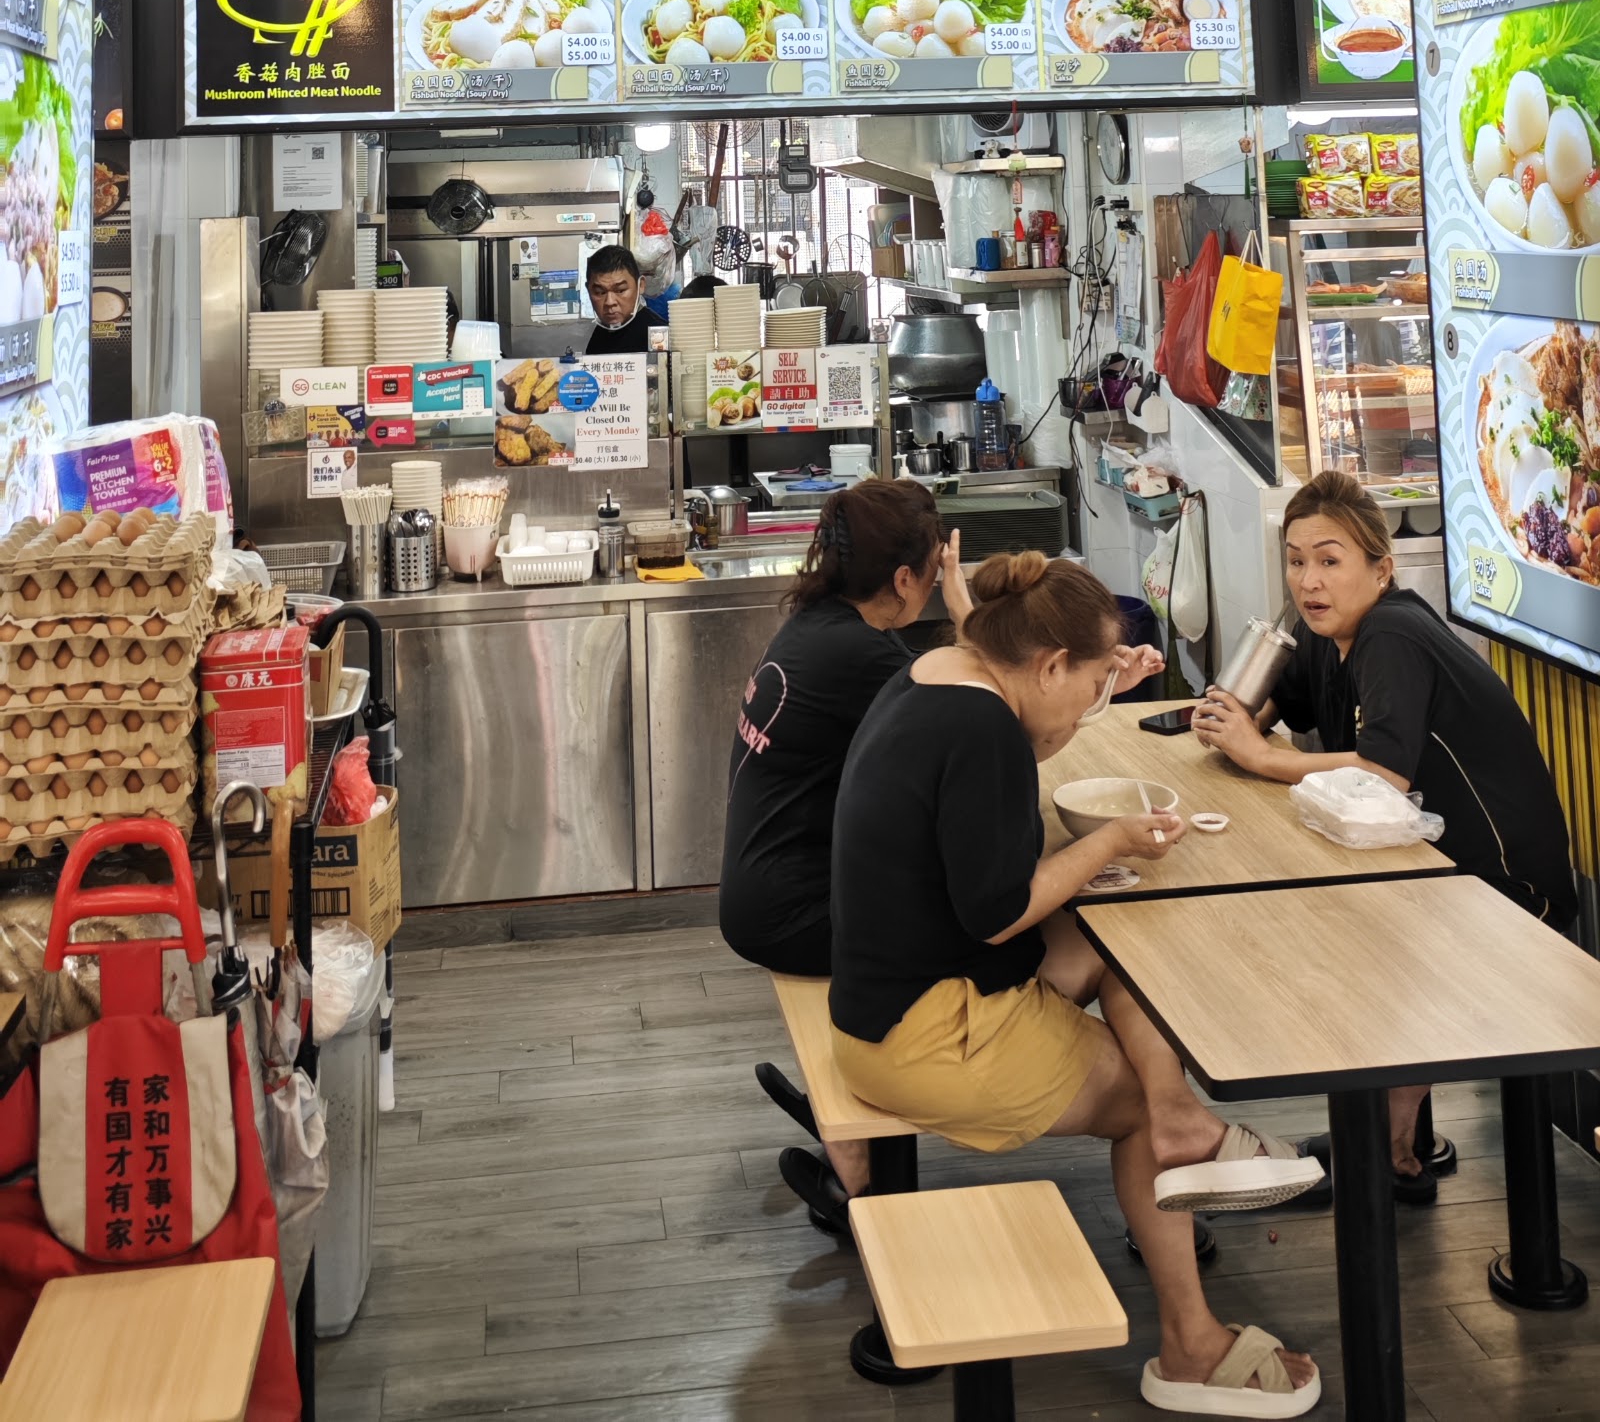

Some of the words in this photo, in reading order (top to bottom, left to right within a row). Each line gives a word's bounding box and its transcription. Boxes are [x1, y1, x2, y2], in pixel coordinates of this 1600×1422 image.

[990, 27, 1019, 36] $4.00
[1021, 29, 1031, 37] (S)
[1195, 23, 1223, 32] $5.30
[1226, 24, 1235, 32] (S)
[567, 37, 597, 47] $4.00
[600, 39, 610, 47] (S)
[781, 32, 810, 42] $4.00
[1196, 36, 1224, 45] $6.30
[1226, 37, 1235, 45] (L)
[991, 40, 1019, 50] $5.00
[1022, 42, 1031, 50] (L)
[782, 46, 811, 55] $5.00
[813, 47, 823, 55] (L)
[568, 51, 597, 61] $5.00
[600, 52, 610, 60] (L)
[1428, 49, 1435, 68] 7
[1054, 74, 1073, 82] Laksa
[685, 84, 705, 93] (Soup
[711, 84, 726, 93] Dry)
[845, 79, 871, 87] Fishball
[873, 79, 889, 88] Soup
[205, 89, 264, 100] Mushroom
[267, 87, 308, 99] Minced
[311, 87, 339, 98] Meat
[341, 85, 381, 97] Noodle
[411, 91, 438, 99] Fishball
[467, 90, 486, 99] (Soup
[493, 90, 508, 99] Dry)
[1447, 330, 1454, 351] 8
[778, 352, 799, 366] SELF
[427, 372, 441, 381] CDC
[442, 368, 469, 378] Voucher
[772, 369, 807, 384] SERVICE
[596, 375, 635, 385] 星期一
[294, 383, 308, 391] SG
[312, 382, 347, 391] CLEAN
[426, 384, 460, 397] Accepted
[443, 393, 460, 402] here
[769, 387, 810, 400] 請自助
[599, 404, 617, 412] Will
[779, 402, 806, 411] digital
[585, 416, 614, 424] Closed
[617, 415, 630, 423] On
[577, 428, 601, 437] Every
[604, 427, 640, 436] Monday
[87, 454, 120, 466] FairPrice
[89, 466, 127, 482] PREMIUM
[92, 476, 134, 491] KITCHEN
[94, 488, 129, 501] TOWEL
[1474, 580, 1491, 599] Laksa
[240, 671, 273, 688] 康元
[312, 845, 350, 861] ara
[104, 1077, 134, 1251] 有国才有家
[142, 1074, 173, 1245] 家和万事兴
